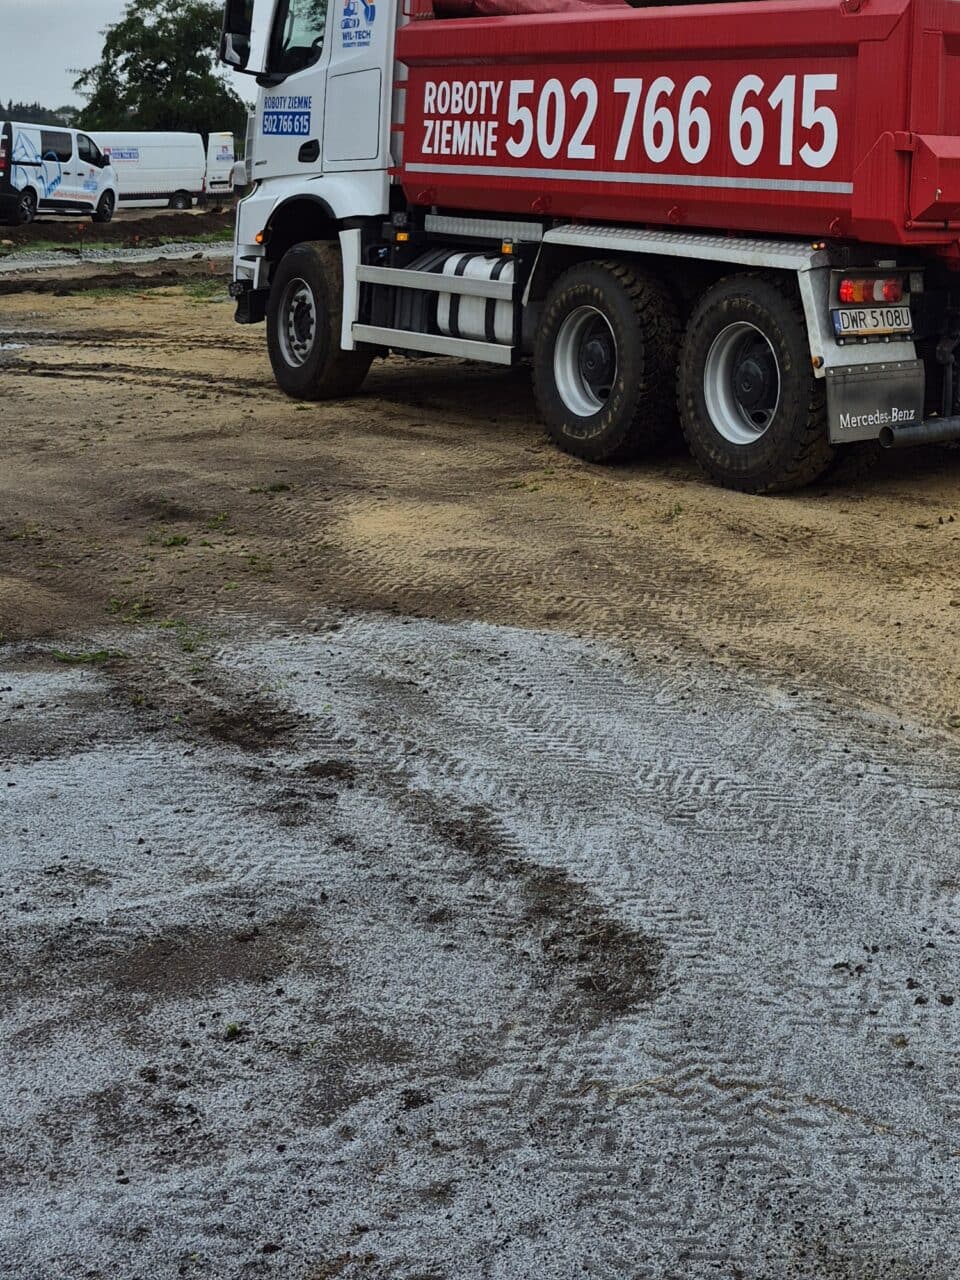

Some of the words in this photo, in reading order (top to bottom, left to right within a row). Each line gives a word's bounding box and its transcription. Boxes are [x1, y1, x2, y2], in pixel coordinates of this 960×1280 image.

[264, 96, 288, 109] ROBOTY
[287, 95, 312, 109] ZIEMNE
[423, 81, 503, 115] ROBOTY
[263, 115, 278, 133] 502
[278, 115, 293, 133] 766
[294, 115, 309, 133] 615
[505, 78, 598, 159] 502
[613, 75, 712, 163] 766
[729, 74, 838, 168] 615
[422, 120, 498, 156] ZIEMNE
[840, 310, 868, 330] DWR
[871, 309, 910, 328] 5108U
[839, 407, 915, 429] Mercedes-Benz
